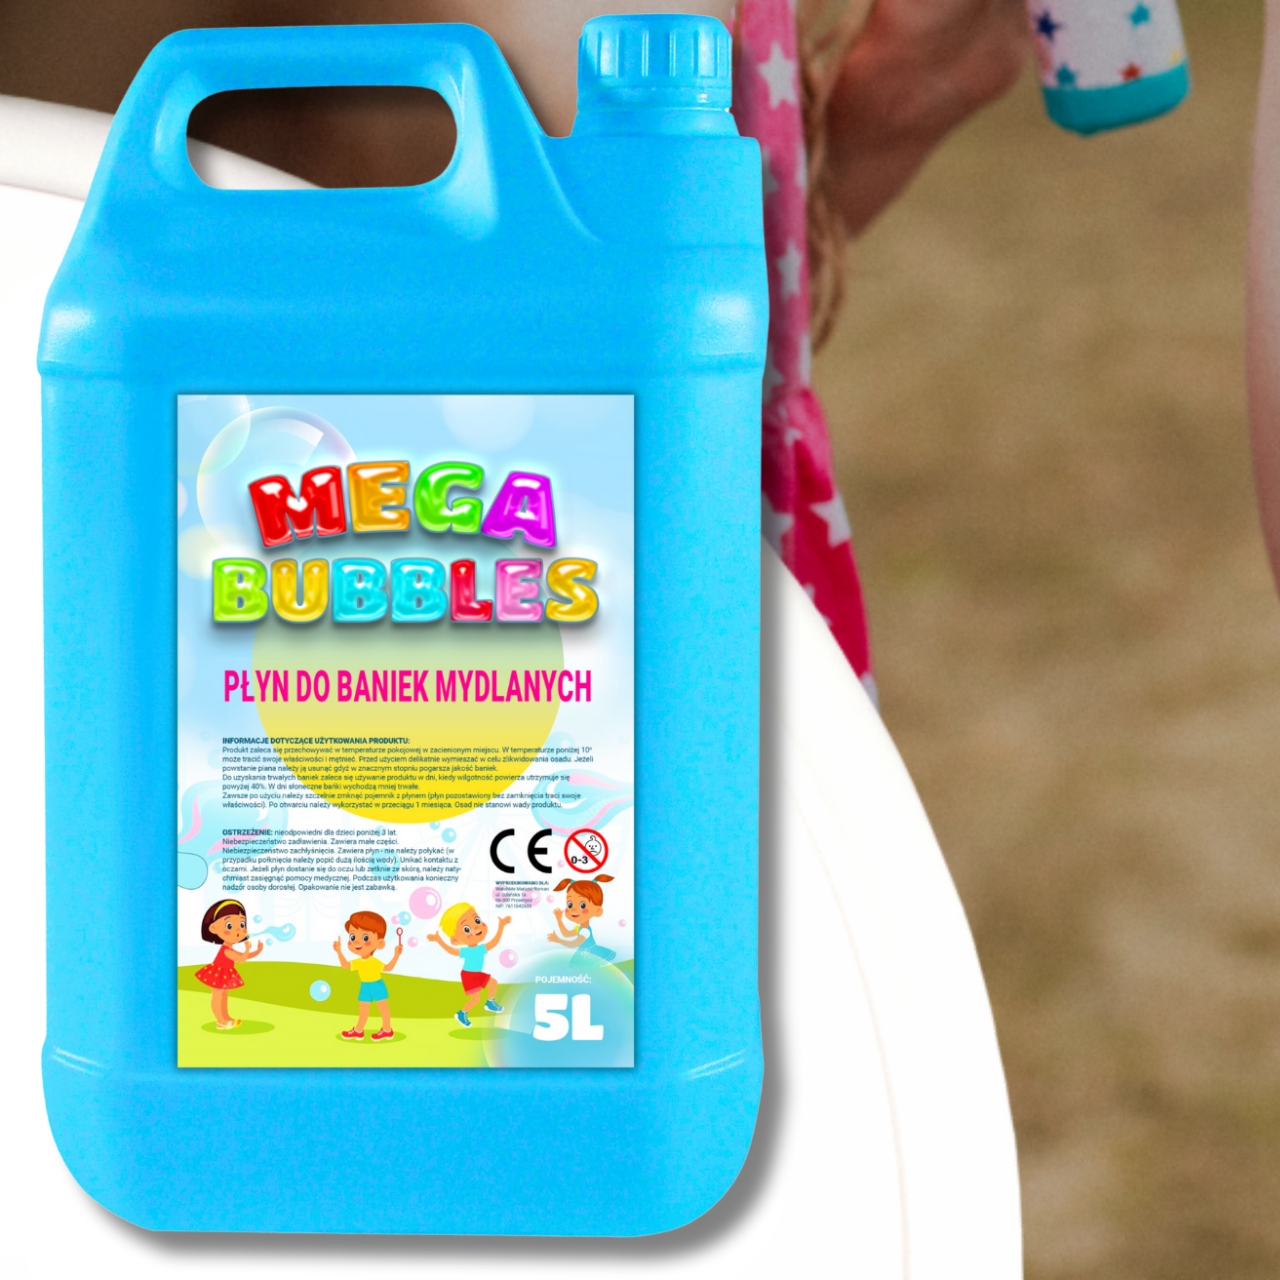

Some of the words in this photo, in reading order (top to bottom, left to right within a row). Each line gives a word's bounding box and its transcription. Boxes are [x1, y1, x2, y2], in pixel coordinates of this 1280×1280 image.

[248, 460, 557, 548] MEGA
[212, 557, 599, 623] BUBBLES
[224, 669, 289, 702] PŁYN
[297, 669, 330, 702] DO
[338, 669, 429, 702] BANIEK
[437, 669, 592, 702] MYDLANYCH
[473, 746, 500, 755] miejscu.
[263, 755, 282, 764] swoje
[258, 764, 276, 773] piana
[394, 764, 418, 773] stopniu
[475, 764, 498, 772] baniek.
[387, 774, 417, 782] produktu
[425, 774, 437, 782] dni,
[439, 774, 456, 782] kiedy
[378, 783, 396, 791] mniej
[365, 792, 395, 800] pojemnik
[562, 792, 581, 800] swoje
[513, 801, 530, 810] wady
[324, 828, 334, 836] dla
[336, 828, 355, 836] dzieci
[388, 828, 398, 836] lat.
[446, 847, 454, 855] (w
[376, 856, 400, 864] wody).
[571, 856, 588, 864] 0-3
[445, 865, 461, 874] naty-
[247, 883, 267, 892] osoby
[352, 883, 364, 892] jest
[535, 974, 592, 984] POJEMNOŚĆ:
[533, 994, 604, 1041] 5L
